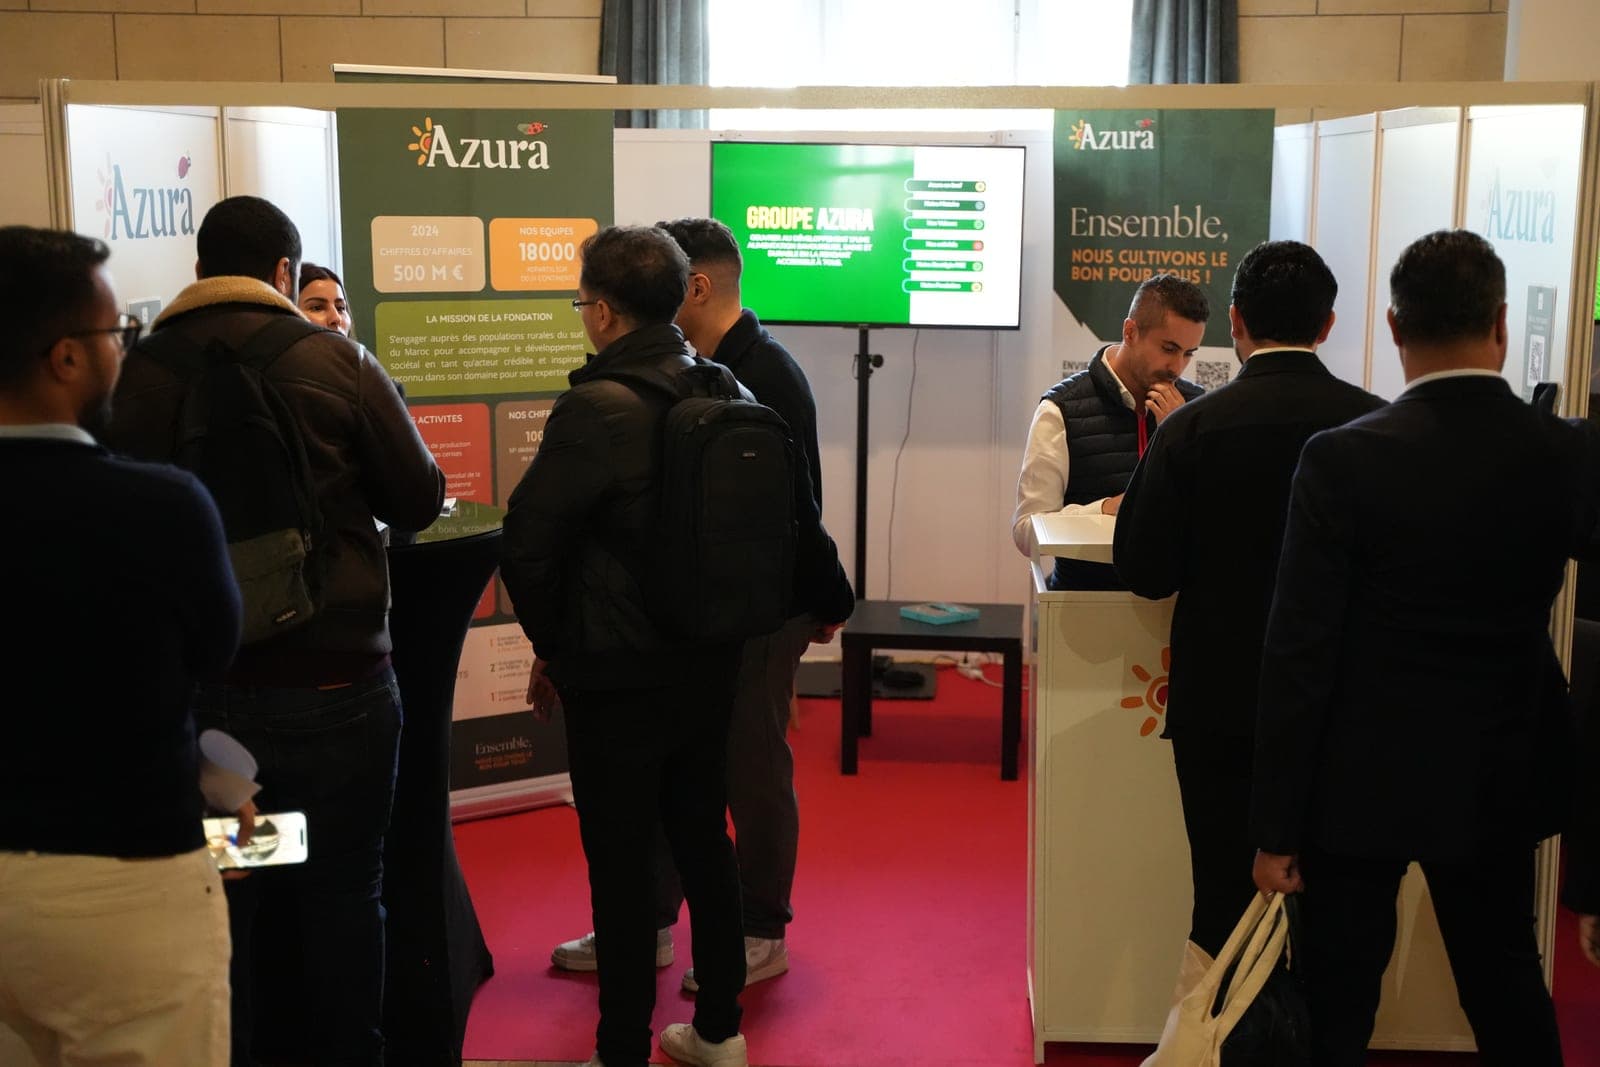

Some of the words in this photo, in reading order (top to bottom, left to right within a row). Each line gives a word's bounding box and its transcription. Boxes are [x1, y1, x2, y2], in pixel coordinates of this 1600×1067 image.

[1080, 123, 1154, 150] Azura
[427, 124, 549, 169] Azura
[111, 164, 195, 240] Azura
[1486, 170, 1556, 244] Azura
[746, 206, 813, 230] GROUPE
[816, 207, 875, 231] AZURA
[1071, 205, 1229, 243] Ensemble,
[411, 225, 439, 237] 2024
[519, 227, 538, 235] NOS
[519, 242, 575, 261] 18000
[1071, 249, 1114, 264] NOUS
[1118, 249, 1207, 267] CULTIVONS
[1211, 251, 1228, 267] LE
[393, 264, 425, 282] 500
[432, 265, 447, 281] M
[452, 264, 464, 281] €
[1071, 266, 1104, 280] BON
[1108, 267, 1153, 283] POUR
[426, 315, 438, 324] LA
[440, 314, 476, 323] MISSION
[478, 314, 489, 322] DE
[491, 313, 501, 322] LA
[504, 313, 553, 322] FONDATION
[389, 334, 427, 345] S'engager
[430, 334, 459, 344] auprès
[462, 333, 477, 342] des
[479, 332, 524, 343] populations
[527, 331, 554, 340] rurales
[557, 331, 567, 339] du
[570, 330, 584, 339] sud
[389, 348, 400, 357] du
[405, 348, 430, 356] Maroc
[434, 348, 454, 358] pour
[458, 346, 510, 356] accompagner
[514, 344, 521, 352] le
[525, 343, 584, 355] développement
[390, 360, 420, 369] sociétal
[441, 360, 457, 368] tant
[463, 359, 498, 369] qu'acteur
[504, 356, 533, 366] crédible
[551, 355, 585, 366] inspirant
[391, 373, 424, 382] reconnu
[425, 372, 446, 381] dans
[447, 373, 462, 381] son
[464, 371, 498, 380] domaine
[499, 371, 518, 380] pour
[519, 370, 533, 378] son
[417, 414, 463, 425] ACTIVITES
[508, 411, 526, 419] NOS
[528, 409, 552, 419] CHIFF
